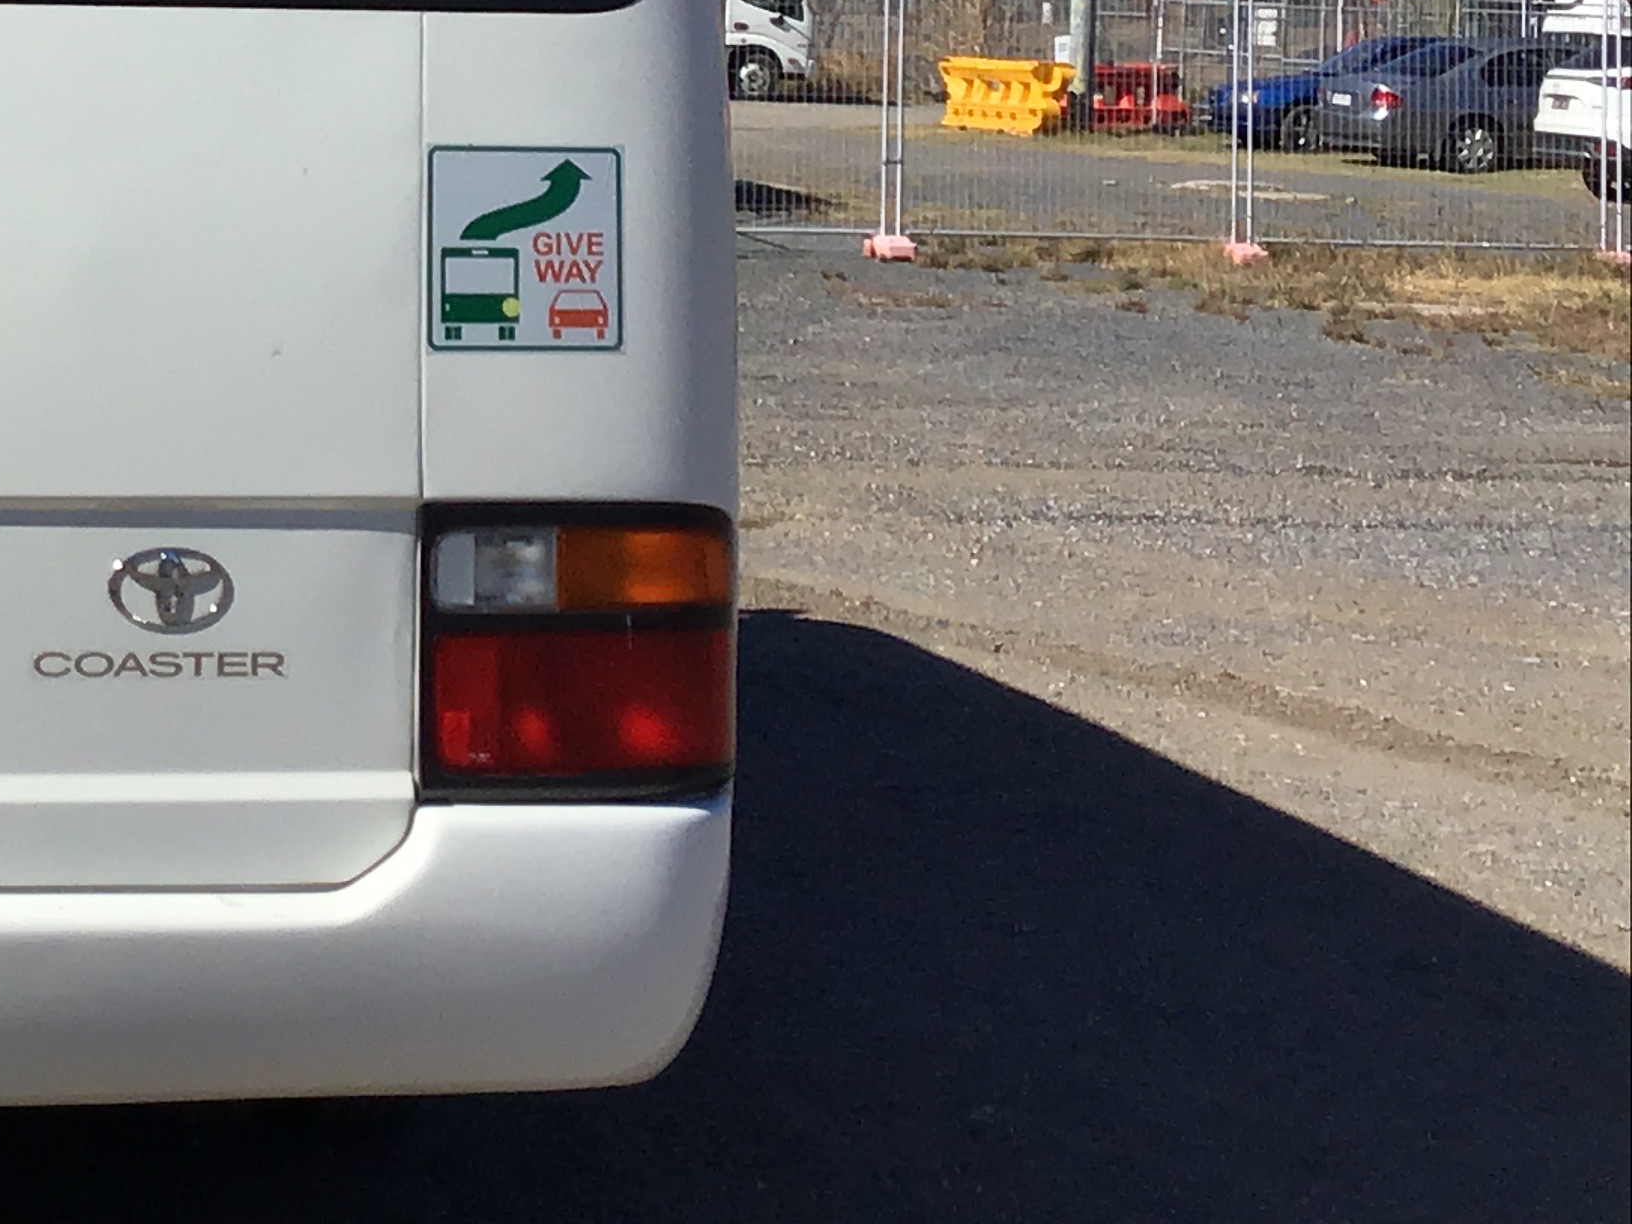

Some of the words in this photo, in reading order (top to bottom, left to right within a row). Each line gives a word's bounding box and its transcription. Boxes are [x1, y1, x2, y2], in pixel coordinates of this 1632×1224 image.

[531, 231, 605, 257] GIVE
[533, 259, 604, 284] WAY
[33, 651, 286, 678] COASTER
